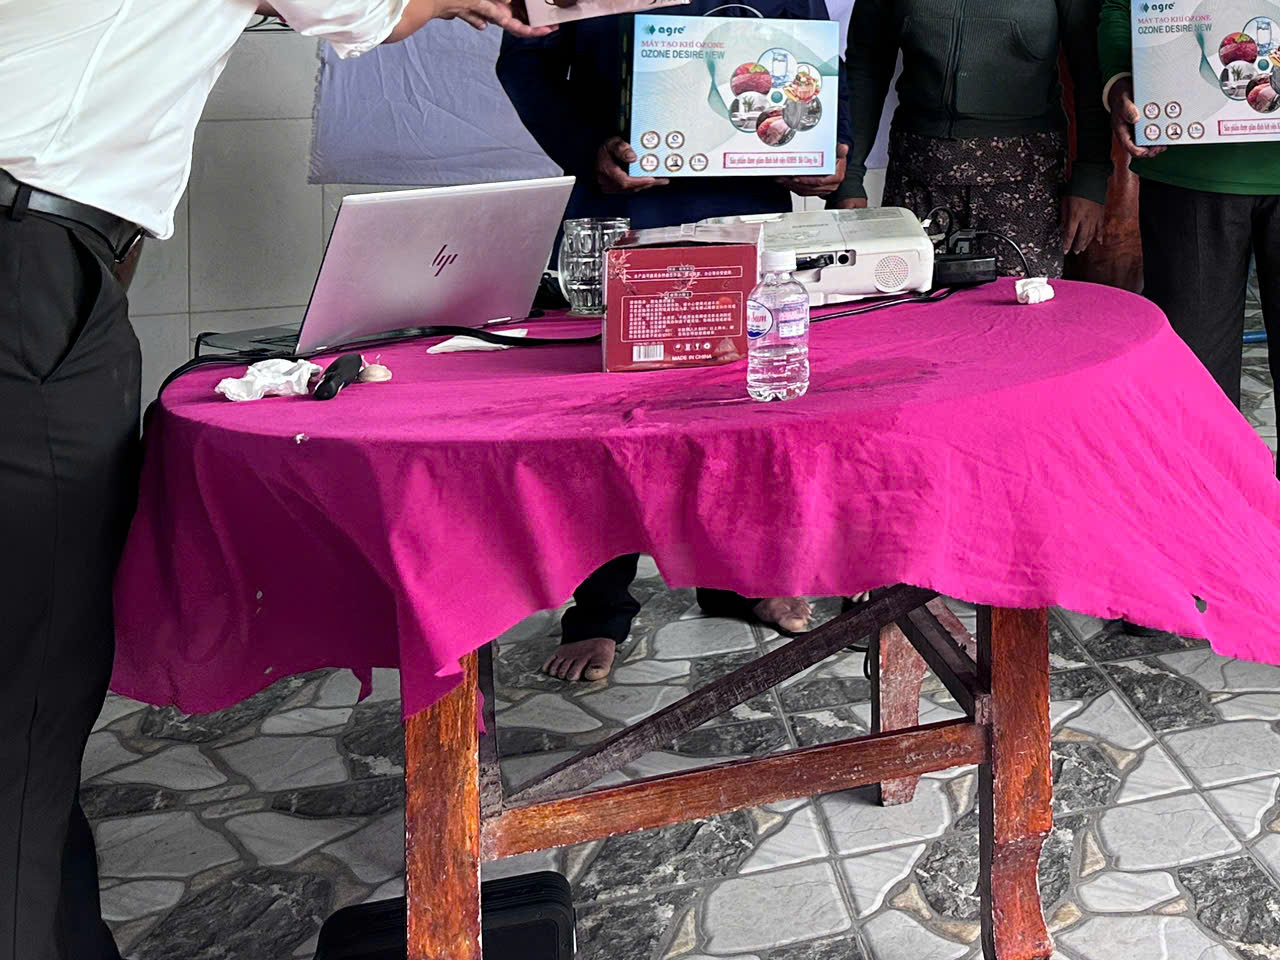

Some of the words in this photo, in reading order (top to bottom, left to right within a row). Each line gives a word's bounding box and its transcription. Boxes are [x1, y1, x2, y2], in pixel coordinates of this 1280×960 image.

[1138, 25, 1164, 35] OZONE
[1165, 24, 1193, 34] DESIRE
[1195, 23, 1212, 32] NEW
[695, 41, 725, 49] OZONE
[641, 49, 671, 58] OZONE
[672, 49, 704, 59] DESIRE
[705, 50, 726, 60] NEW
[431, 243, 459, 278] hp
